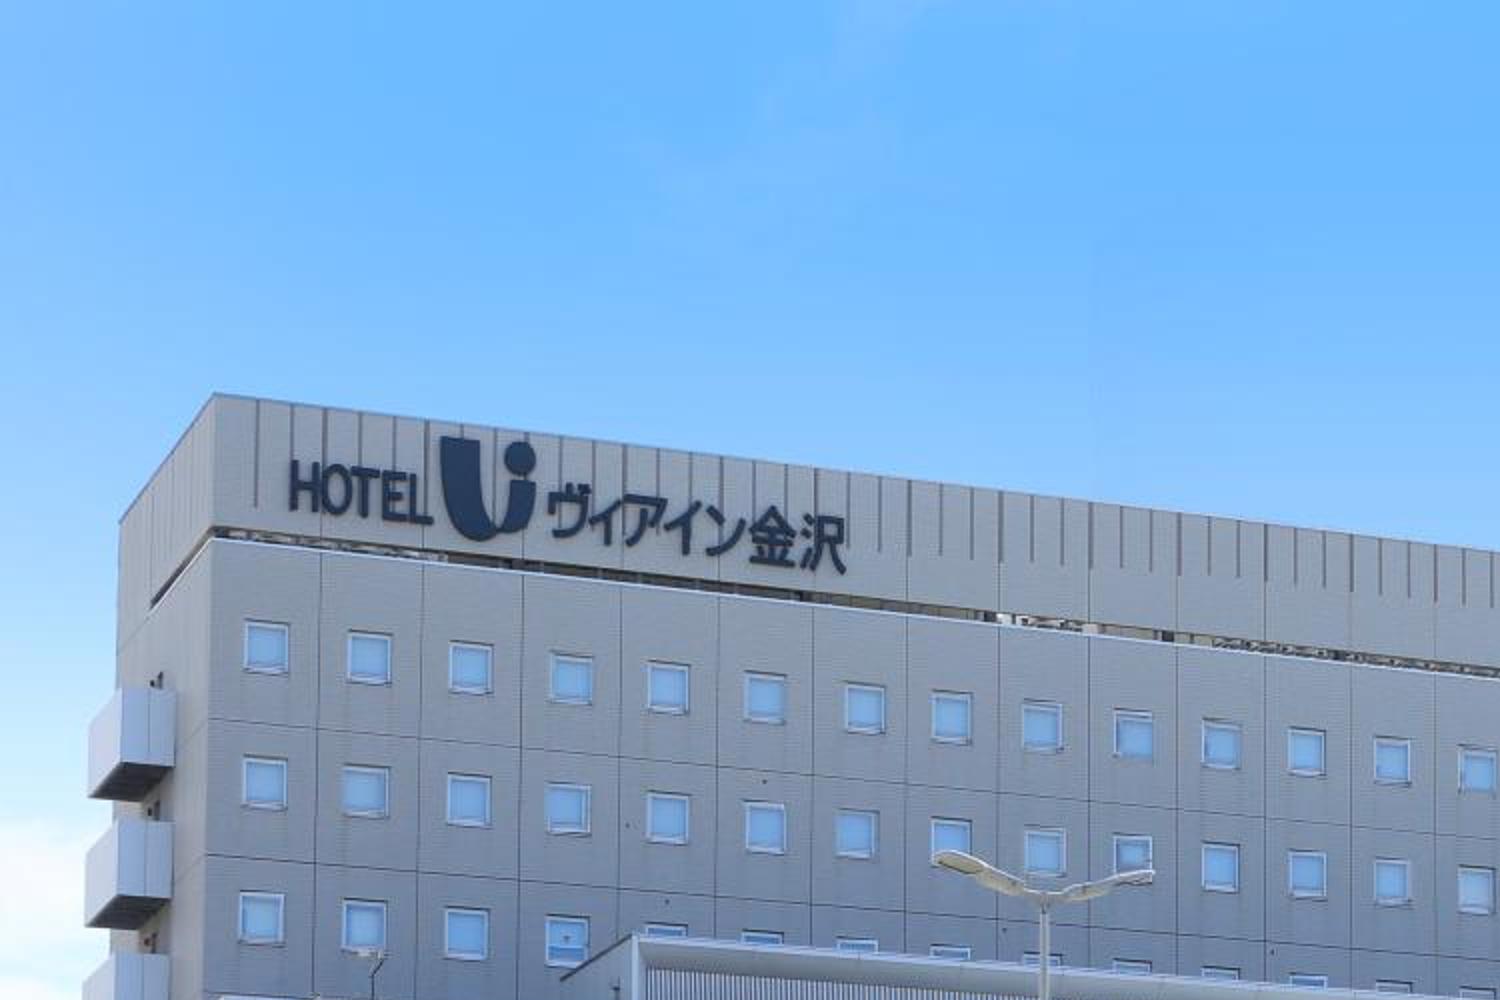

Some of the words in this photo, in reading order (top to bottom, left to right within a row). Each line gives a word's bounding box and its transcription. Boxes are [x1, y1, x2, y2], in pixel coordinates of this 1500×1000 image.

[289, 459, 434, 526] HOTEL
[548, 482, 847, 576] ヴィアイン金沢
